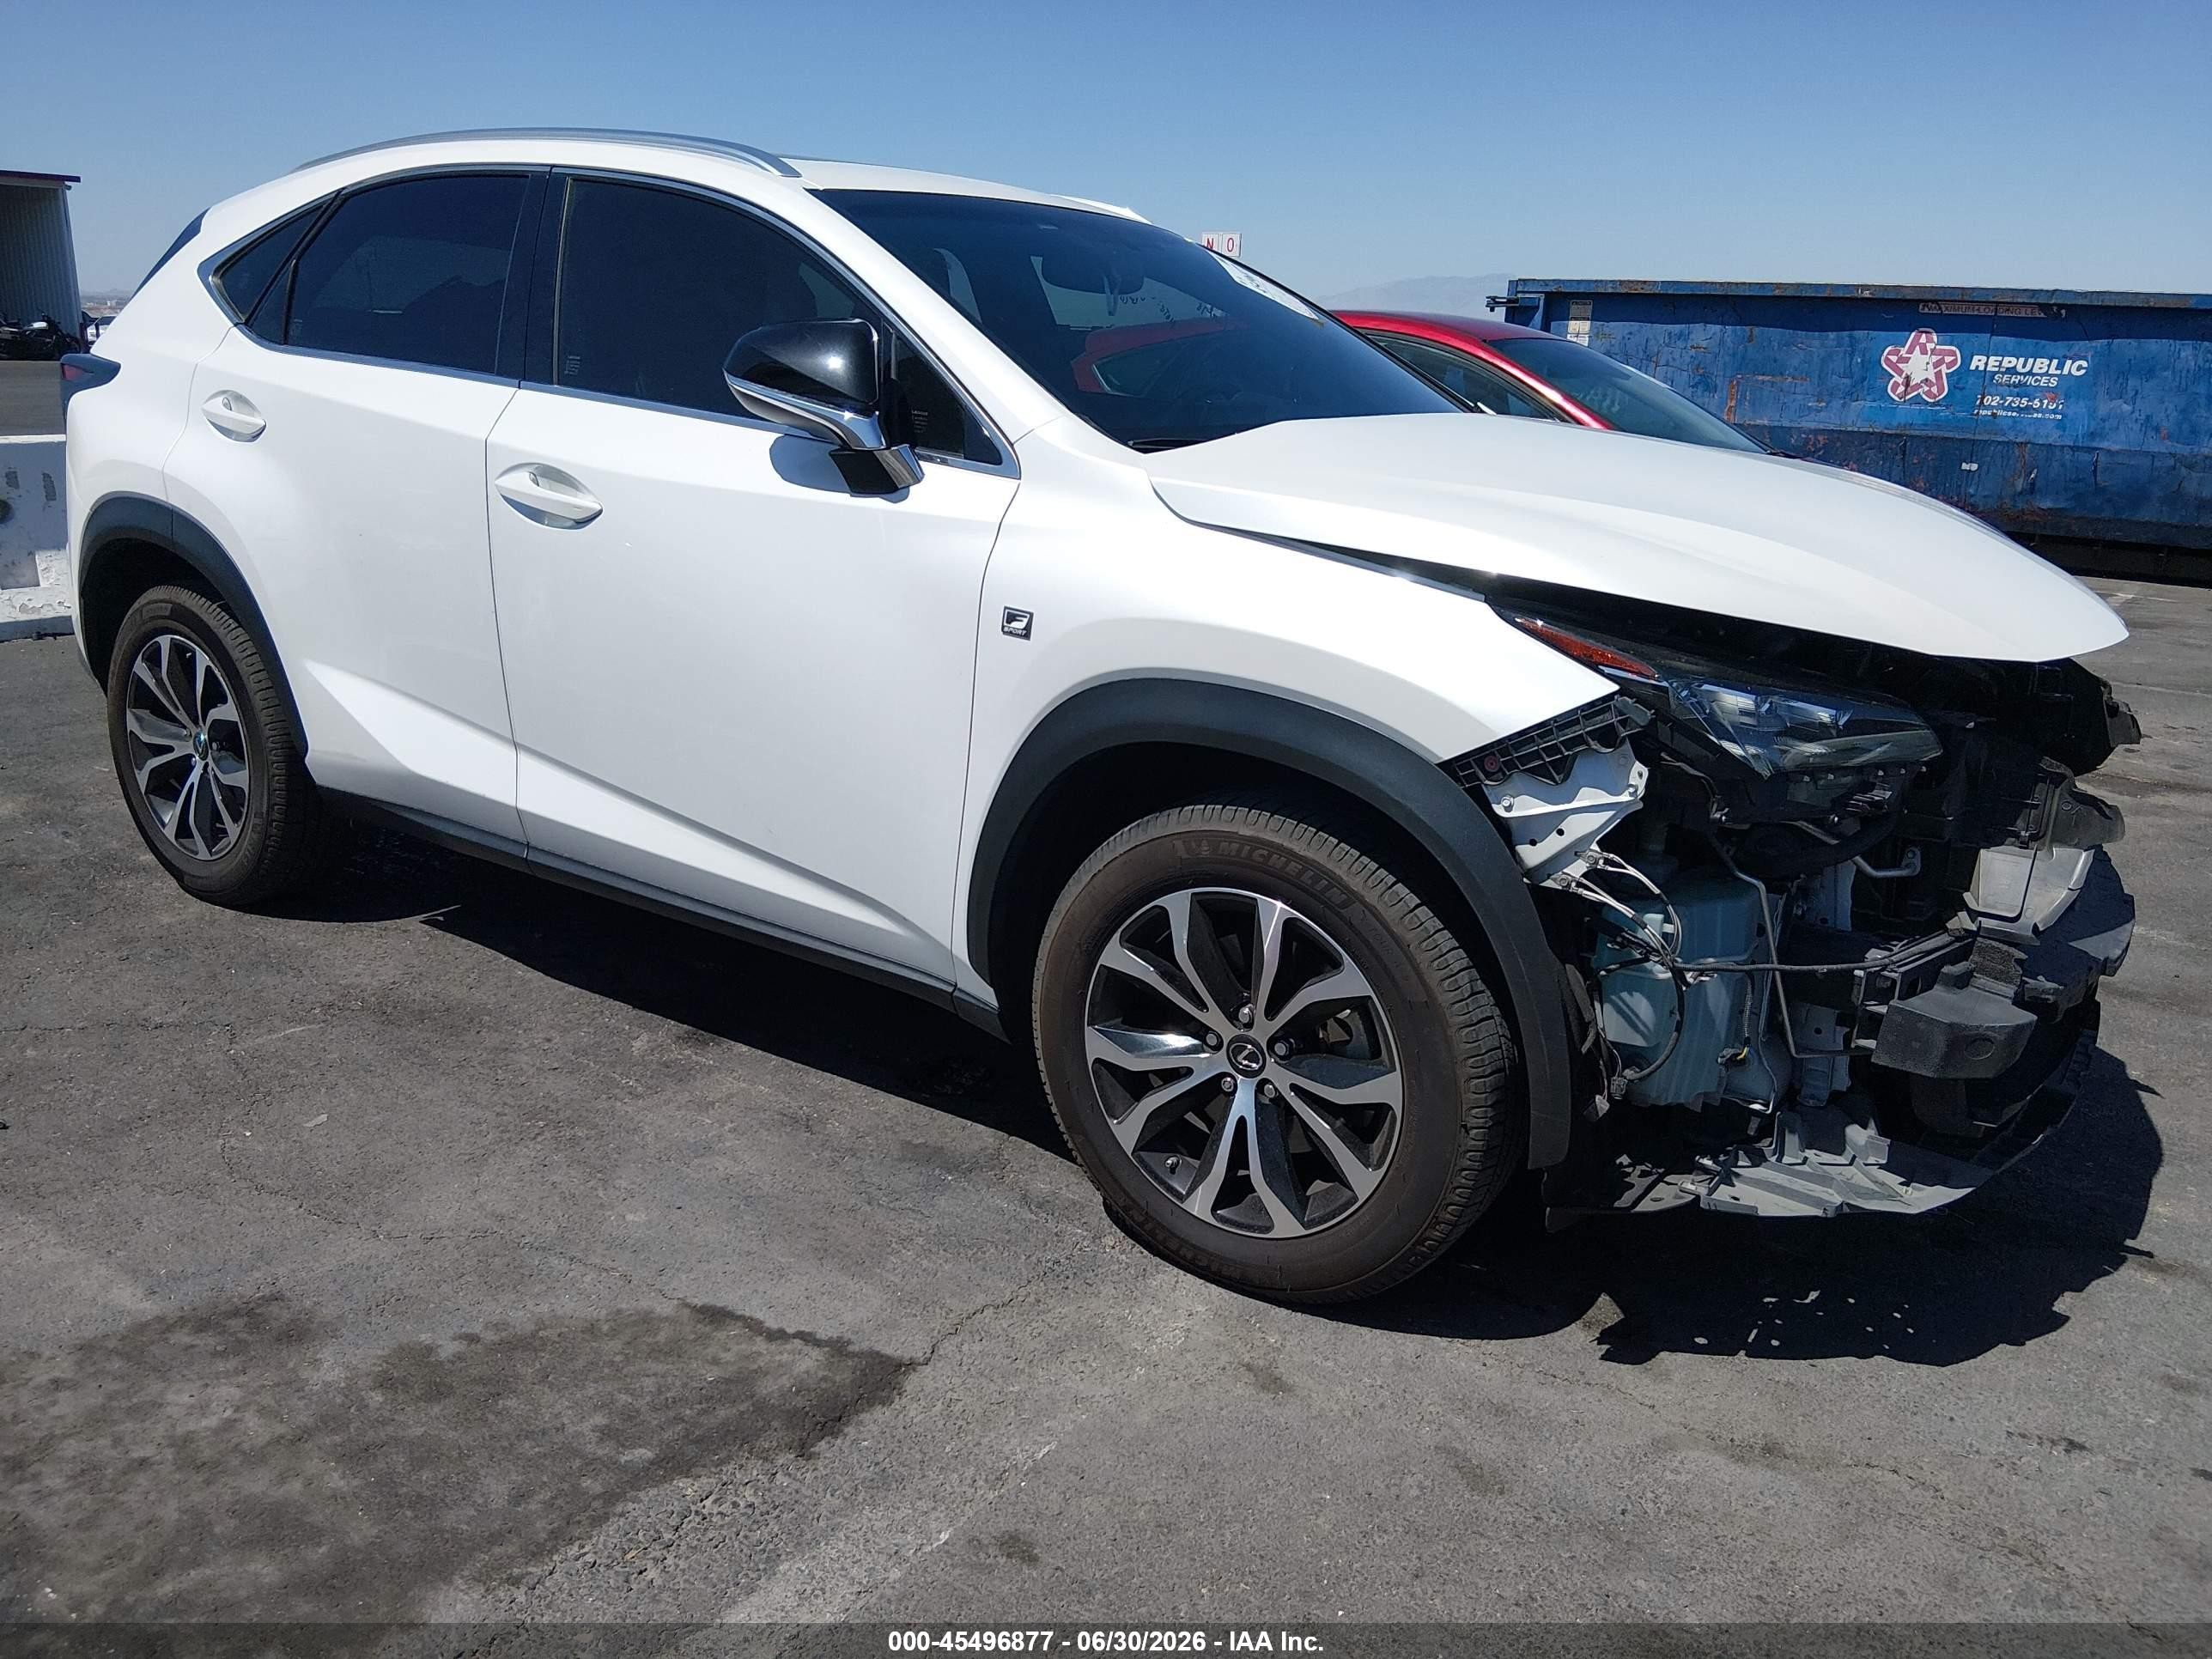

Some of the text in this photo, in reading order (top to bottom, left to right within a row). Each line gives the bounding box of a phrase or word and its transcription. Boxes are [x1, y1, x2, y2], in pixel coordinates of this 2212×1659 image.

[1969, 355, 2088, 376] REPUBLIC
[1993, 374, 2058, 387] SERVICES
[1003, 626, 1027, 636] SPORT
[1217, 841, 1347, 907] MICHELIN
